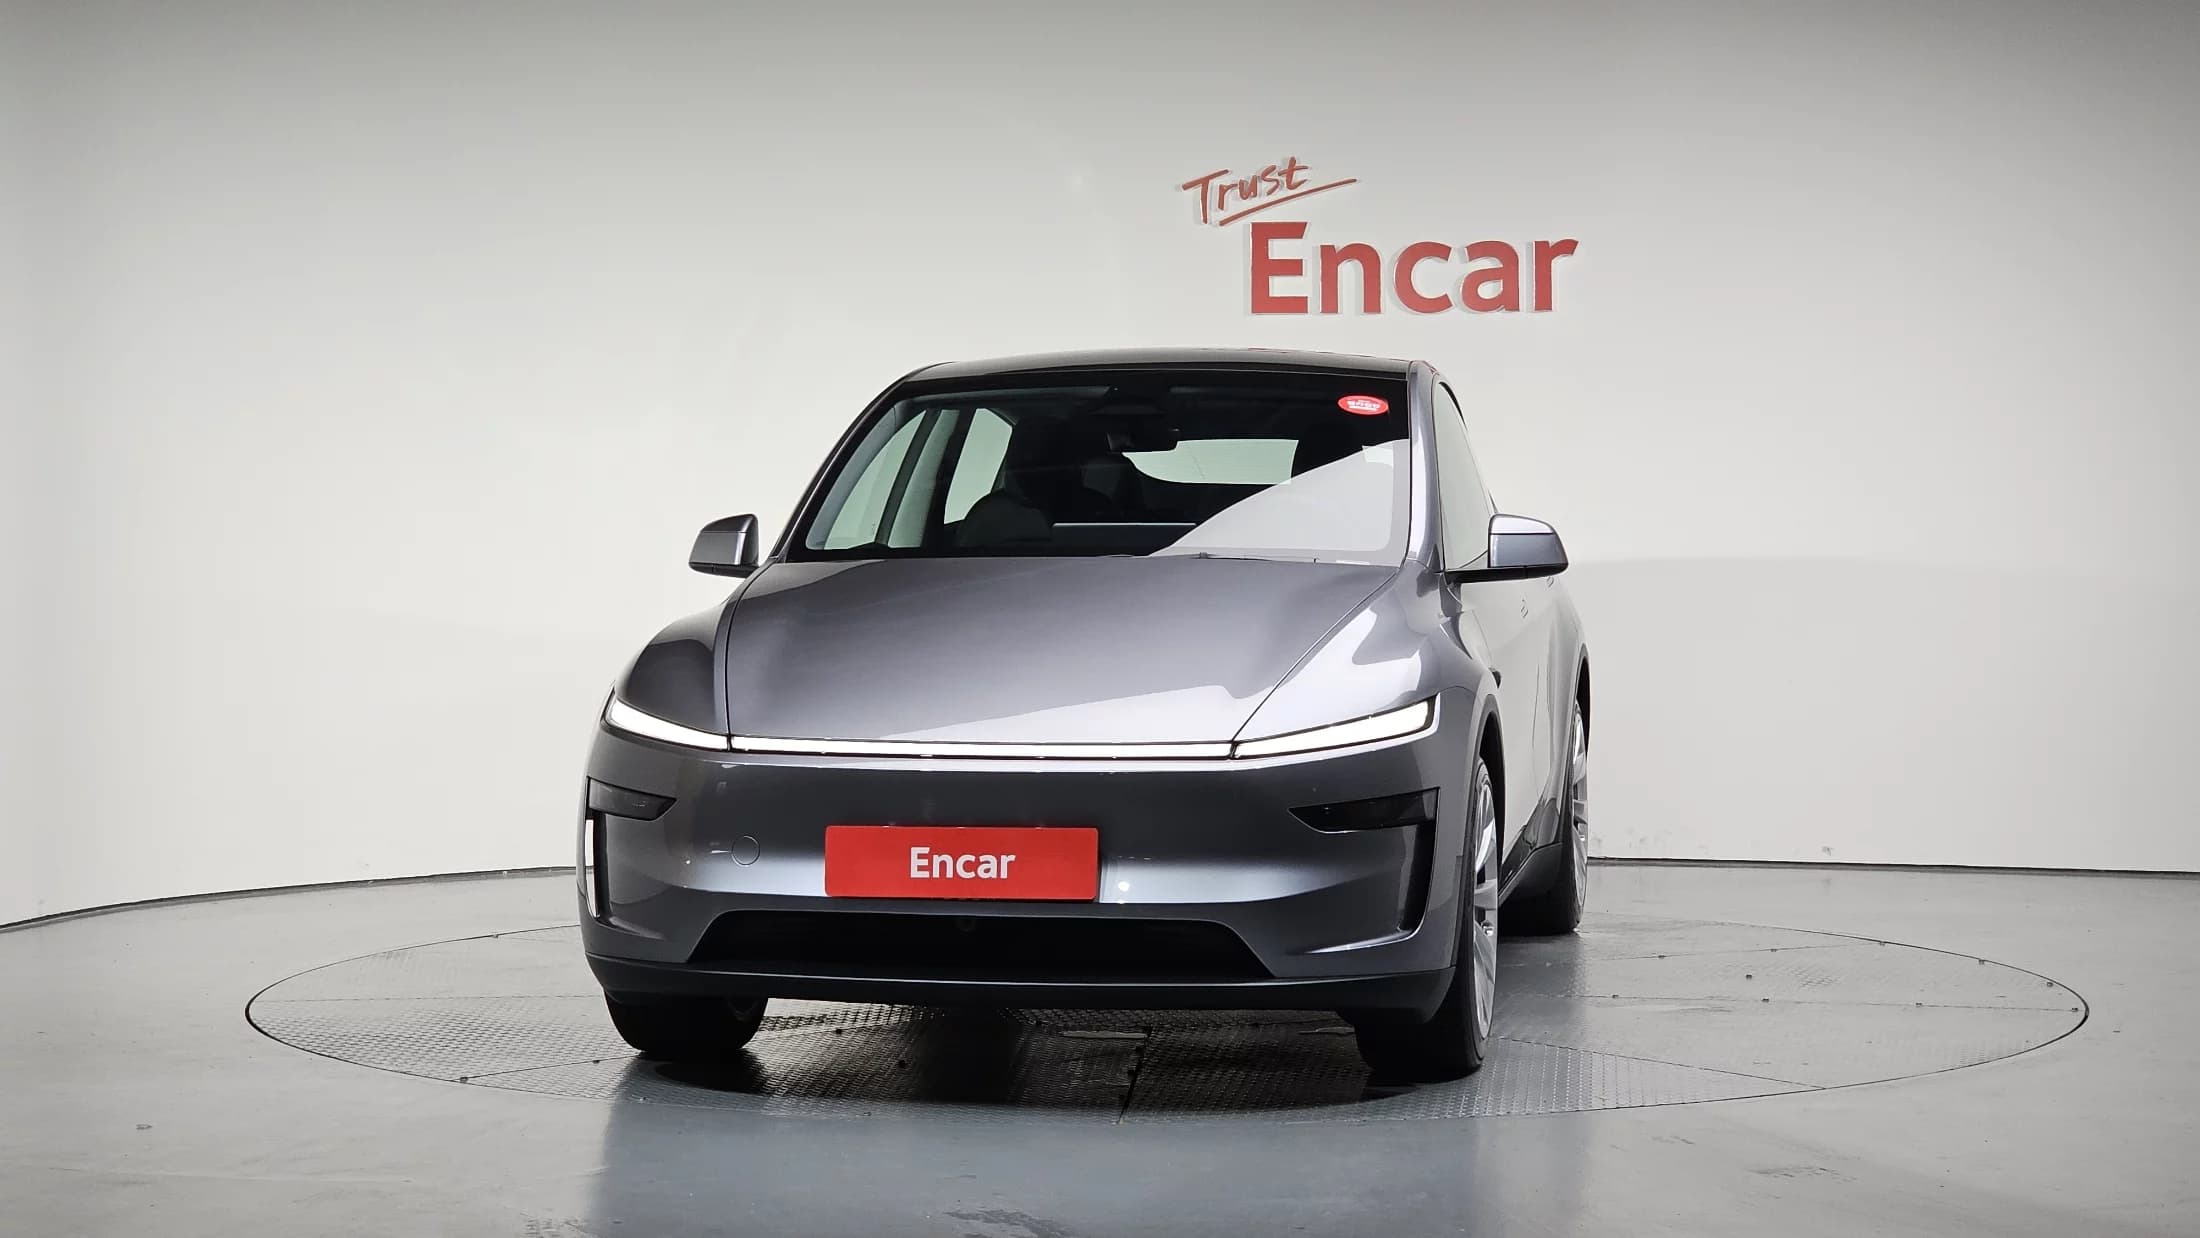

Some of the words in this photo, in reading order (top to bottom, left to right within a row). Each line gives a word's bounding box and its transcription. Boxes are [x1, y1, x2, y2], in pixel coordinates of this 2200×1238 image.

[1182, 156, 1310, 225] Trust
[1249, 221, 1580, 315] Encar
[910, 846, 1016, 879] Encar
